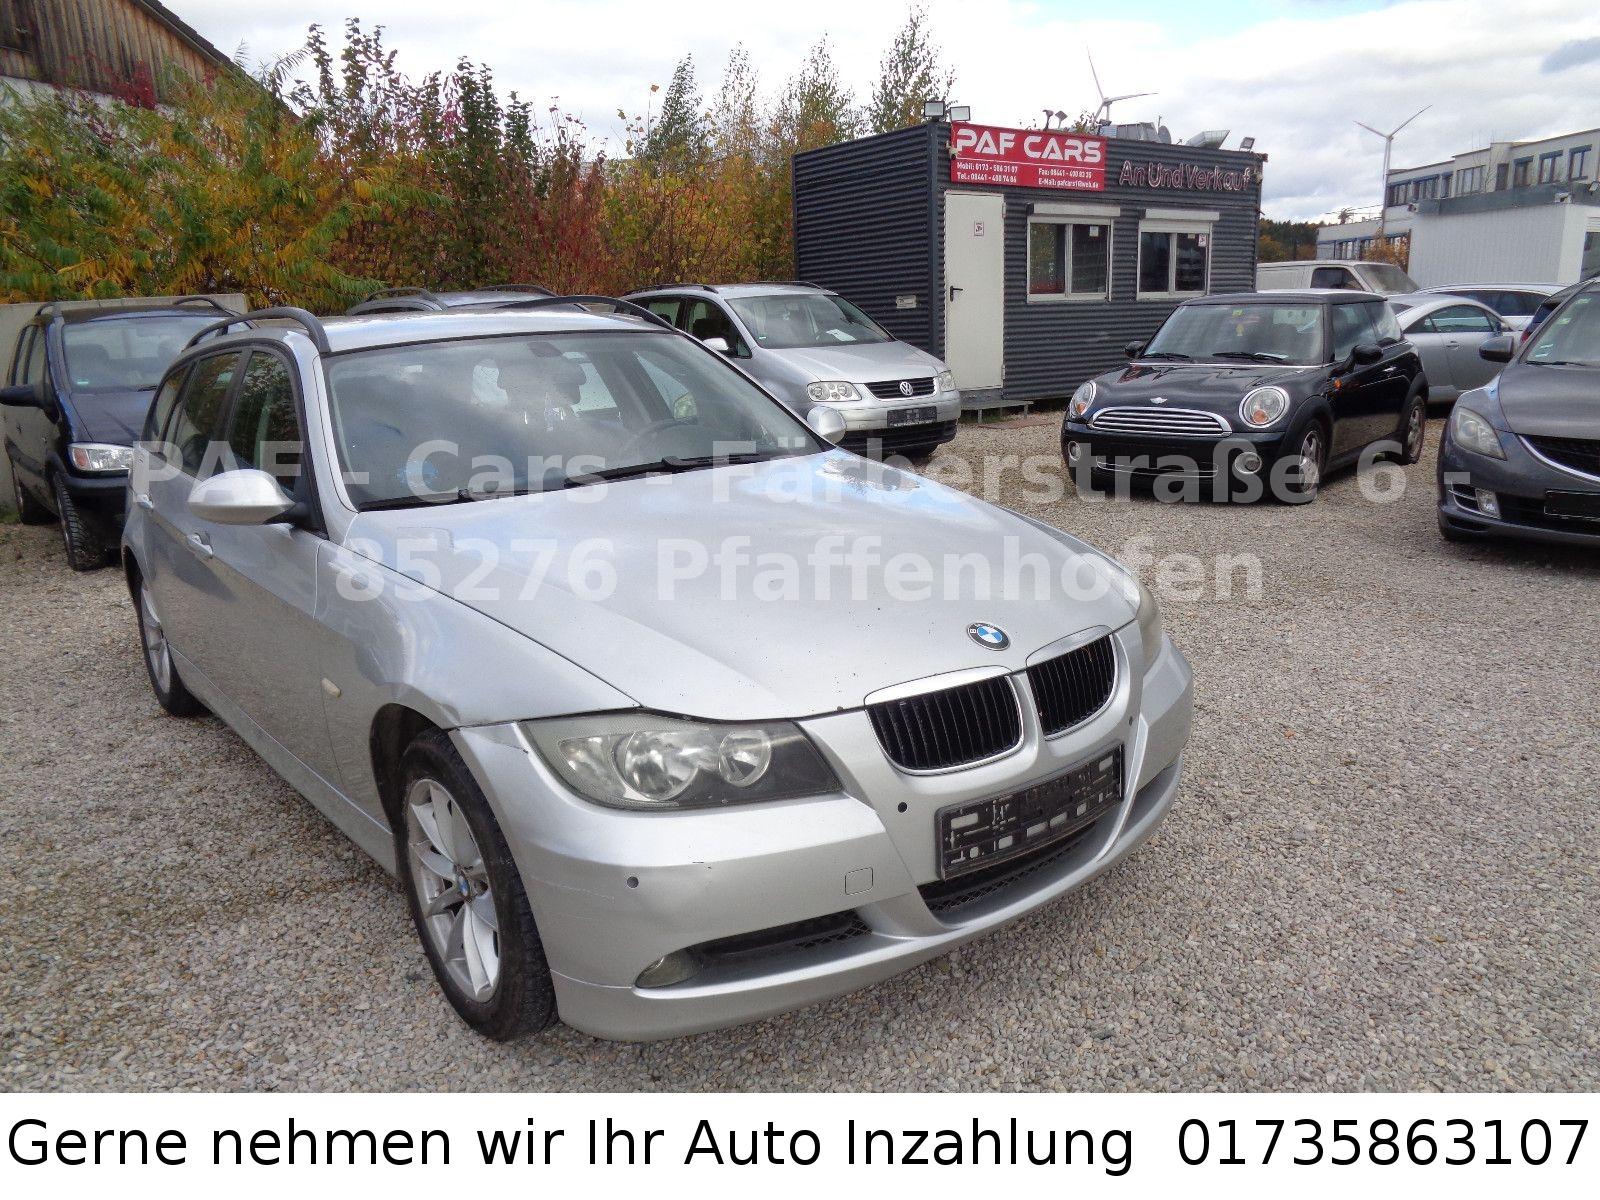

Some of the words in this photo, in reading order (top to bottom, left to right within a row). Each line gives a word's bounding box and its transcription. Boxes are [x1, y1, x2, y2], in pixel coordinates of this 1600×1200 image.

[957, 129, 1015, 155] PAF
[1024, 135, 1101, 163] CARS
[957, 162, 975, 170] Mobil:
[1119, 160, 1145, 186] An
[1149, 163, 1184, 188] Und
[1186, 165, 1250, 190] Verkauf
